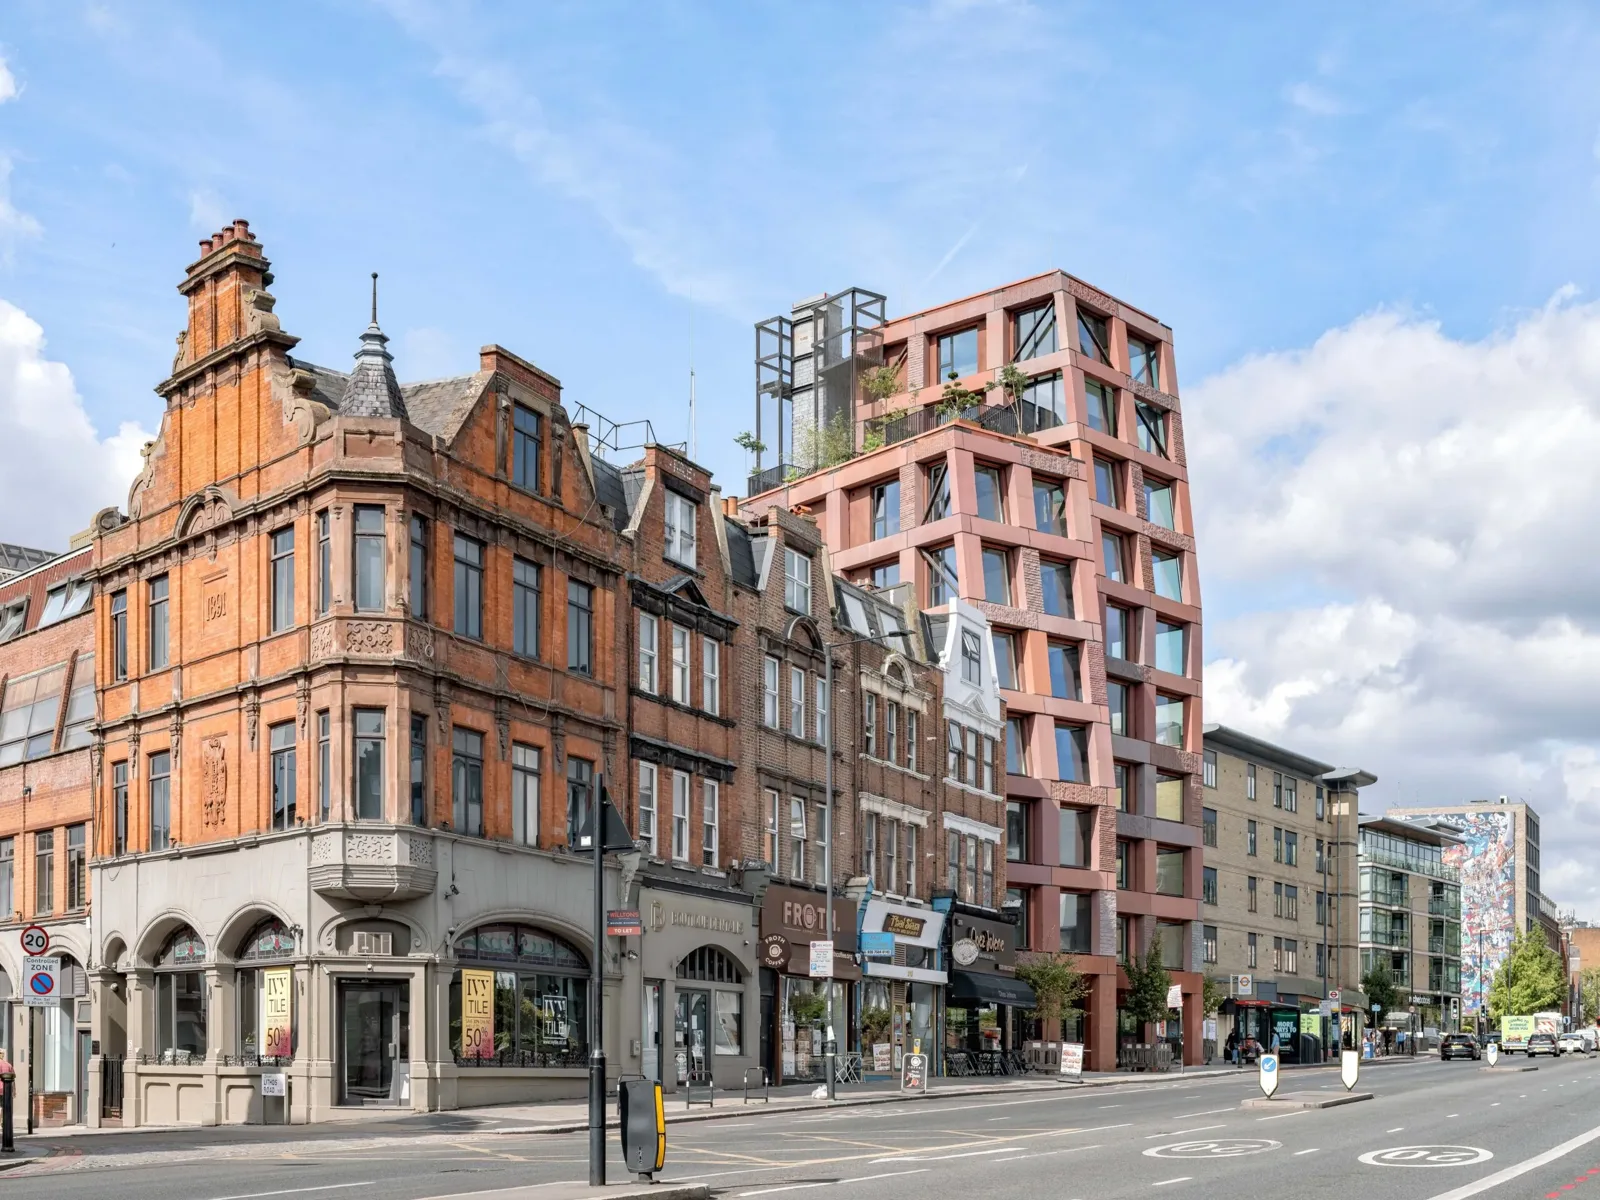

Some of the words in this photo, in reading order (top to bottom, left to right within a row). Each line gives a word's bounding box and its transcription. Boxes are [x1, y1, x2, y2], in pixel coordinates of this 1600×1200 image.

[206, 592, 226, 621] 1891
[671, 911, 708, 929] BOUTIQUE
[25, 934, 45, 947] 20
[765, 935, 785, 944] FROTH
[765, 957, 785, 965] COFFEE
[268, 977, 286, 995] IVY
[467, 978, 489, 996] IVY
[269, 998, 286, 1013] TILE
[468, 1000, 488, 1014] TILE
[545, 1000, 565, 1017] IVY
[545, 1020, 565, 1035] TILE
[466, 1027, 488, 1047] 50%
